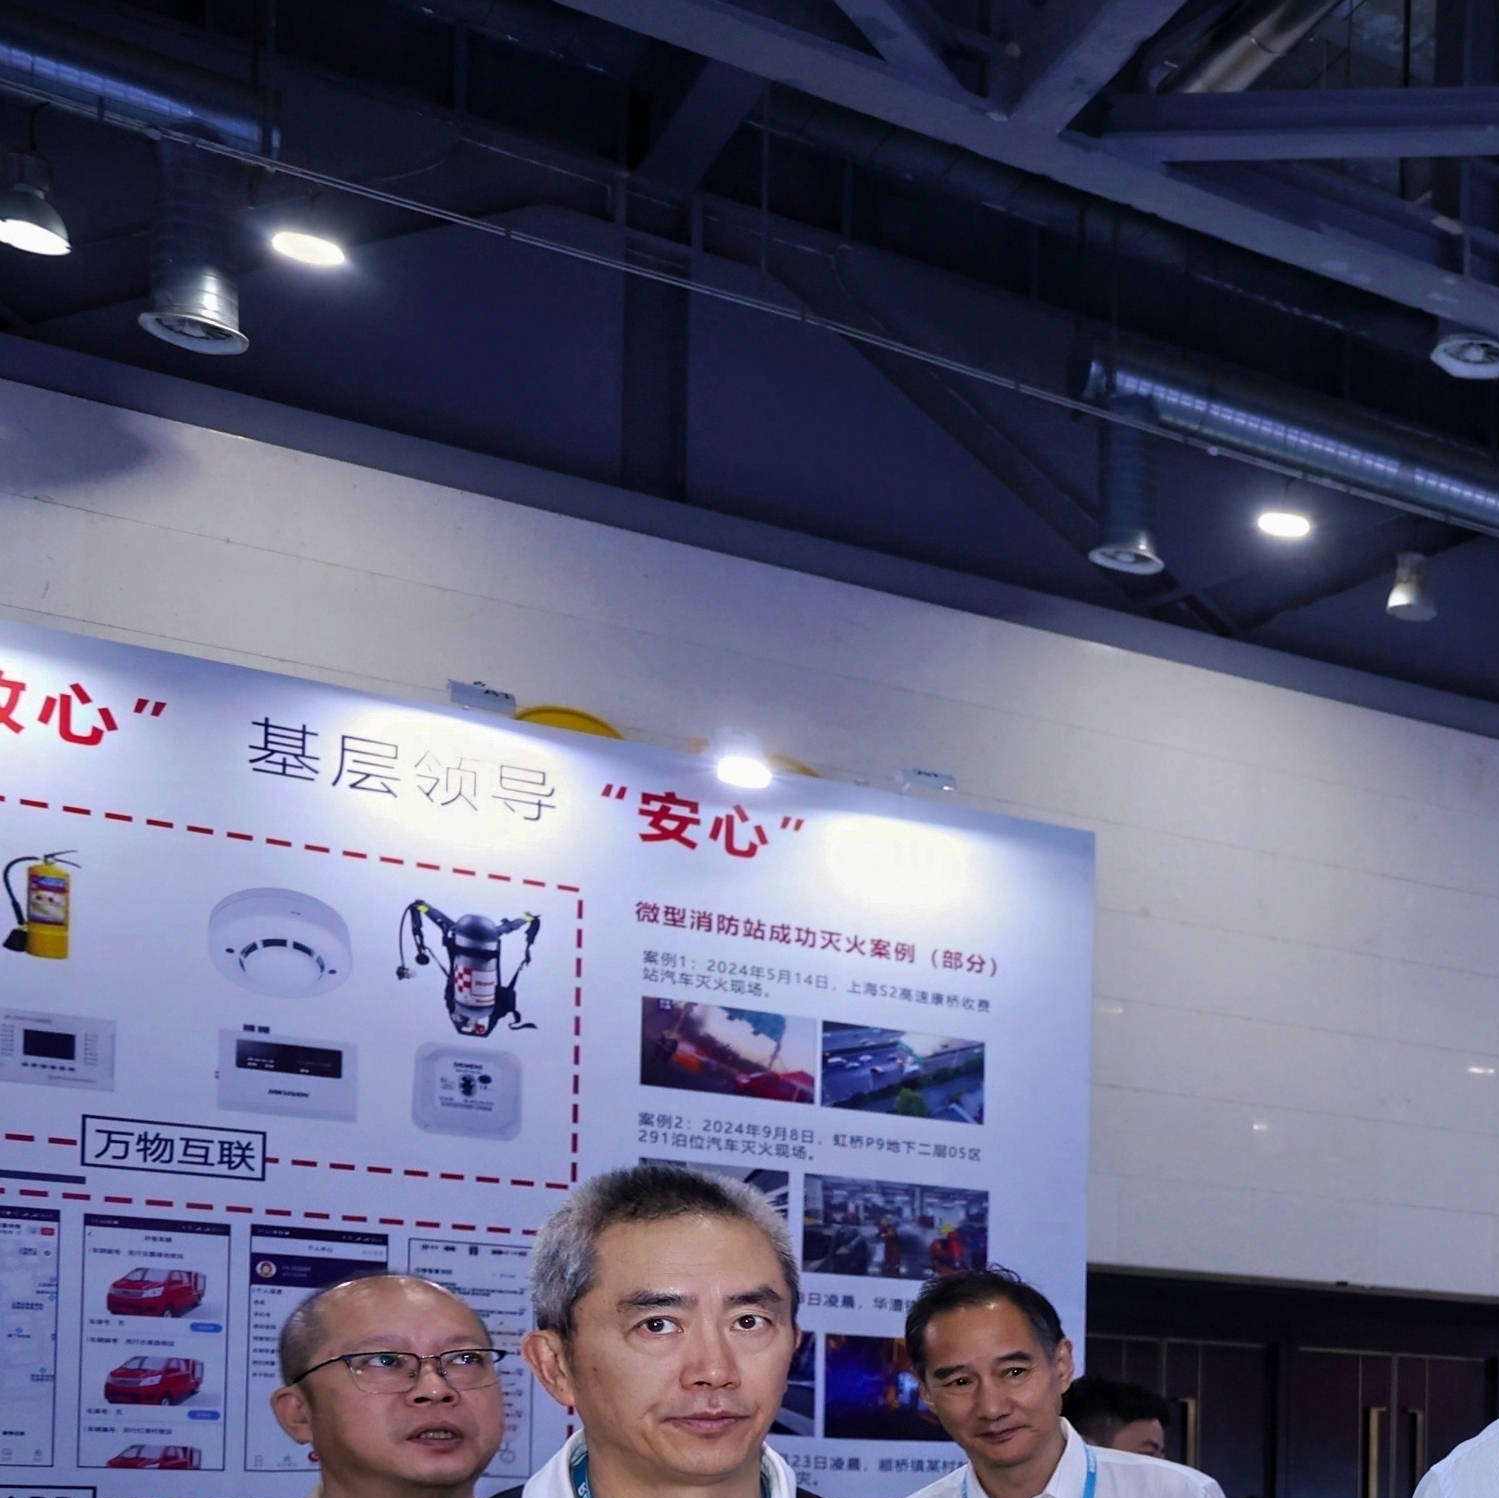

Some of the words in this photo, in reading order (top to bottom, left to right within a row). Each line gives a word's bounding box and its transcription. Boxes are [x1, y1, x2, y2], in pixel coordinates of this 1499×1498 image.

[248, 717, 556, 821] 基层领导
[95, 1127, 256, 1173] 万物互联
